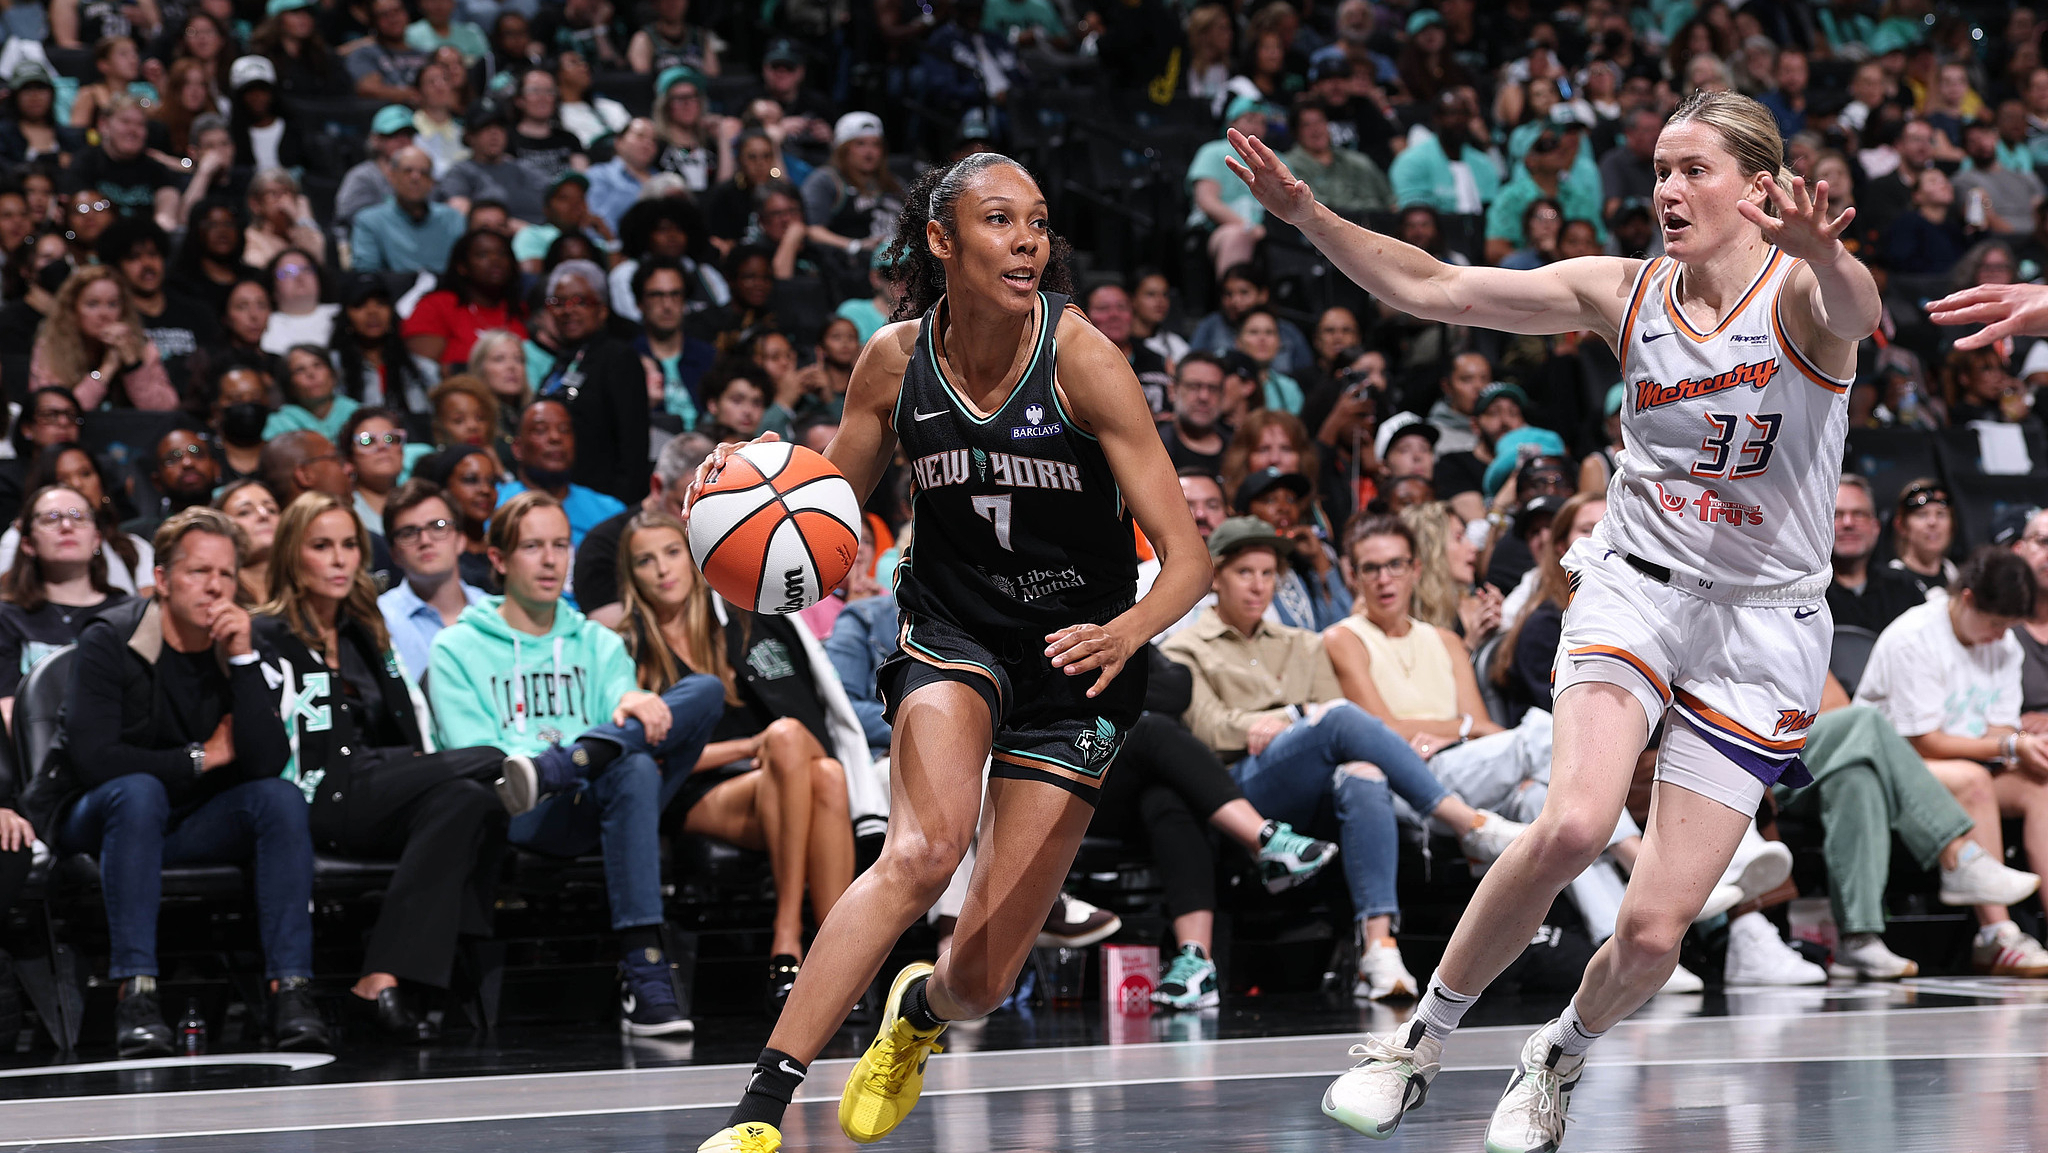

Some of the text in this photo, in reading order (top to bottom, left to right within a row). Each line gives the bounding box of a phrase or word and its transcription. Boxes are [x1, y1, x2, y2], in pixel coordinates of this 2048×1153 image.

[1635, 357, 1780, 414] Mercury
[1013, 424, 1060, 438] BARCLAYS
[1690, 411, 1783, 480] 33
[913, 449, 1083, 492] NEW YORK
[970, 493, 1014, 552] 7
[1692, 489, 1764, 526] fry's
[1017, 565, 1075, 587] Liberty
[1021, 575, 1087, 602] Mutual
